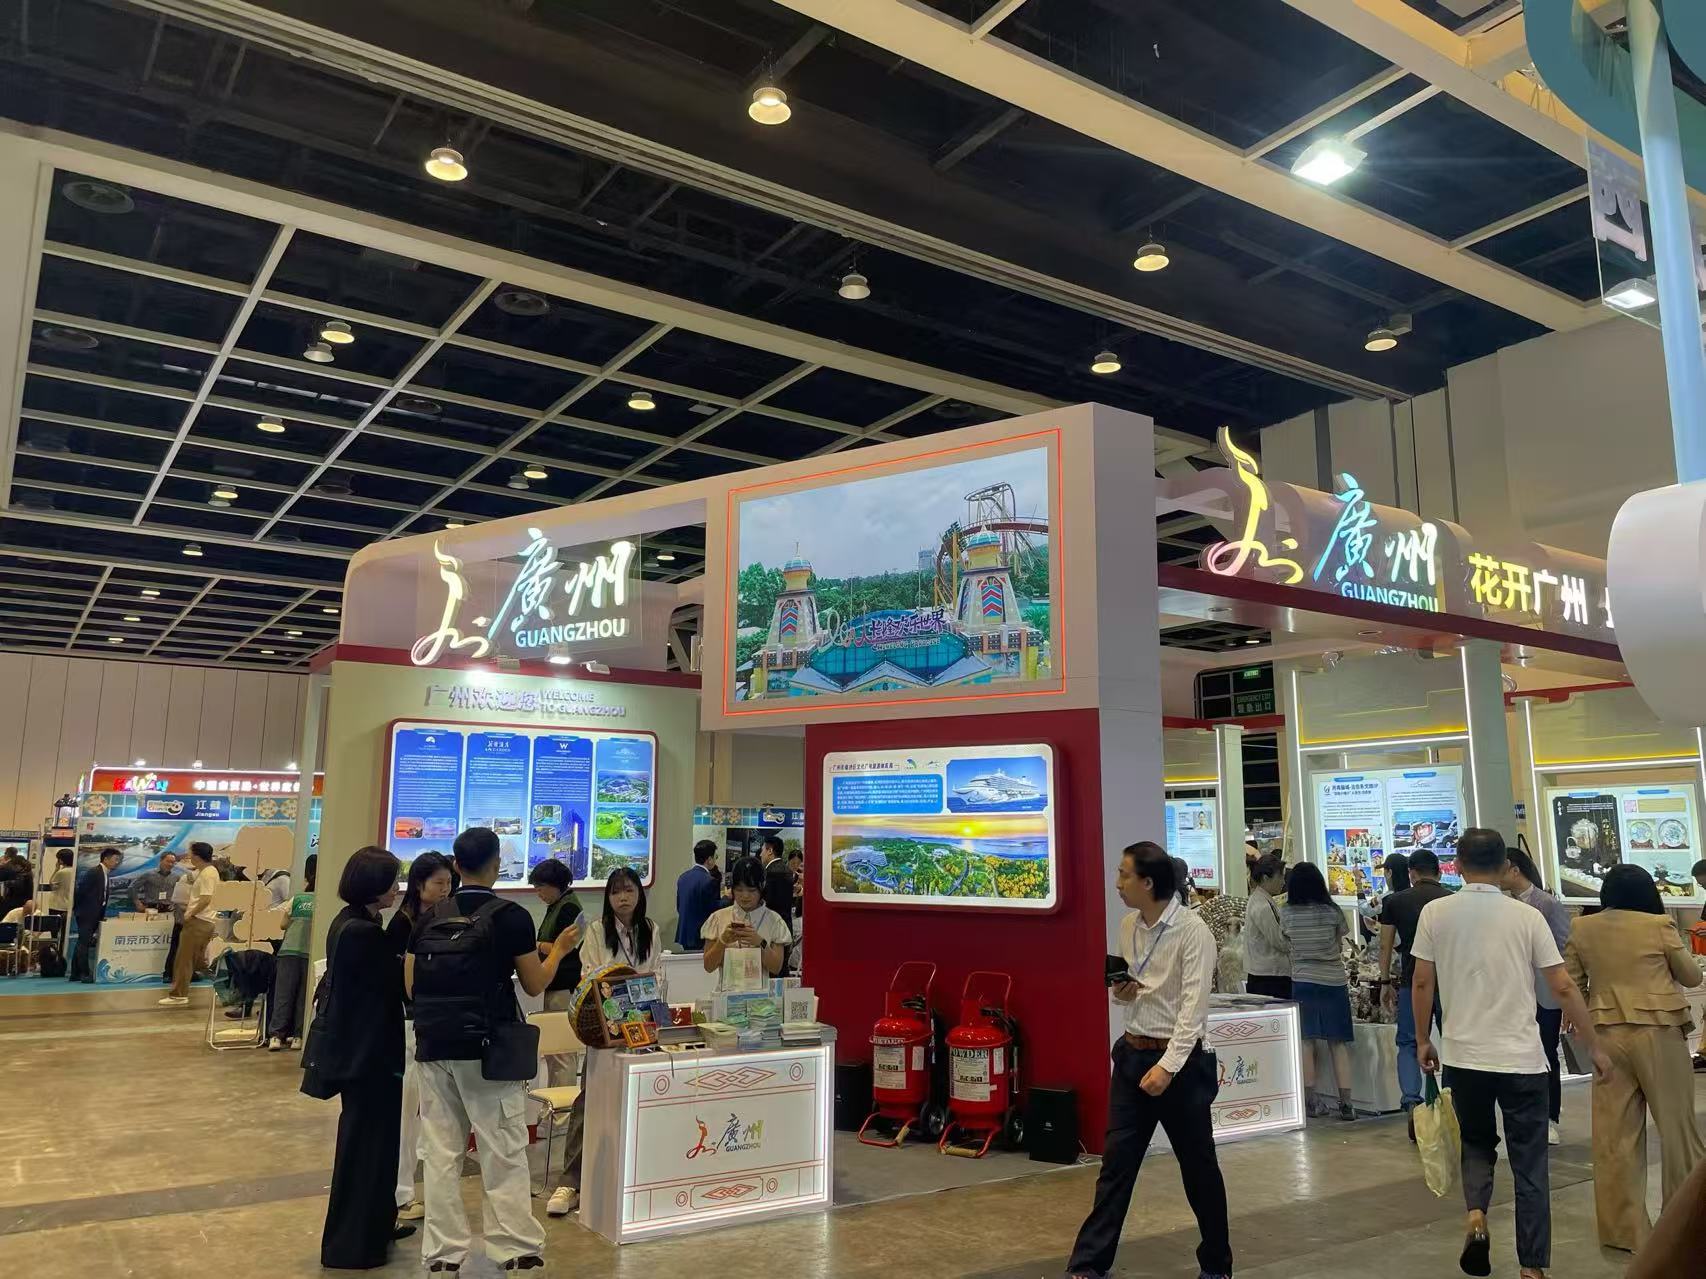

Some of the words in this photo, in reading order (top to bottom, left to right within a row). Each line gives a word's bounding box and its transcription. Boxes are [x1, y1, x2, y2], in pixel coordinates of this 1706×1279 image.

[1341, 581, 1438, 613] GUANGZHOU
[1468, 553, 1589, 626] 花开广州
[515, 618, 626, 648] GUANGZHOU
[541, 688, 595, 703] WELCOME
[558, 704, 627, 718] GUANGZHOU
